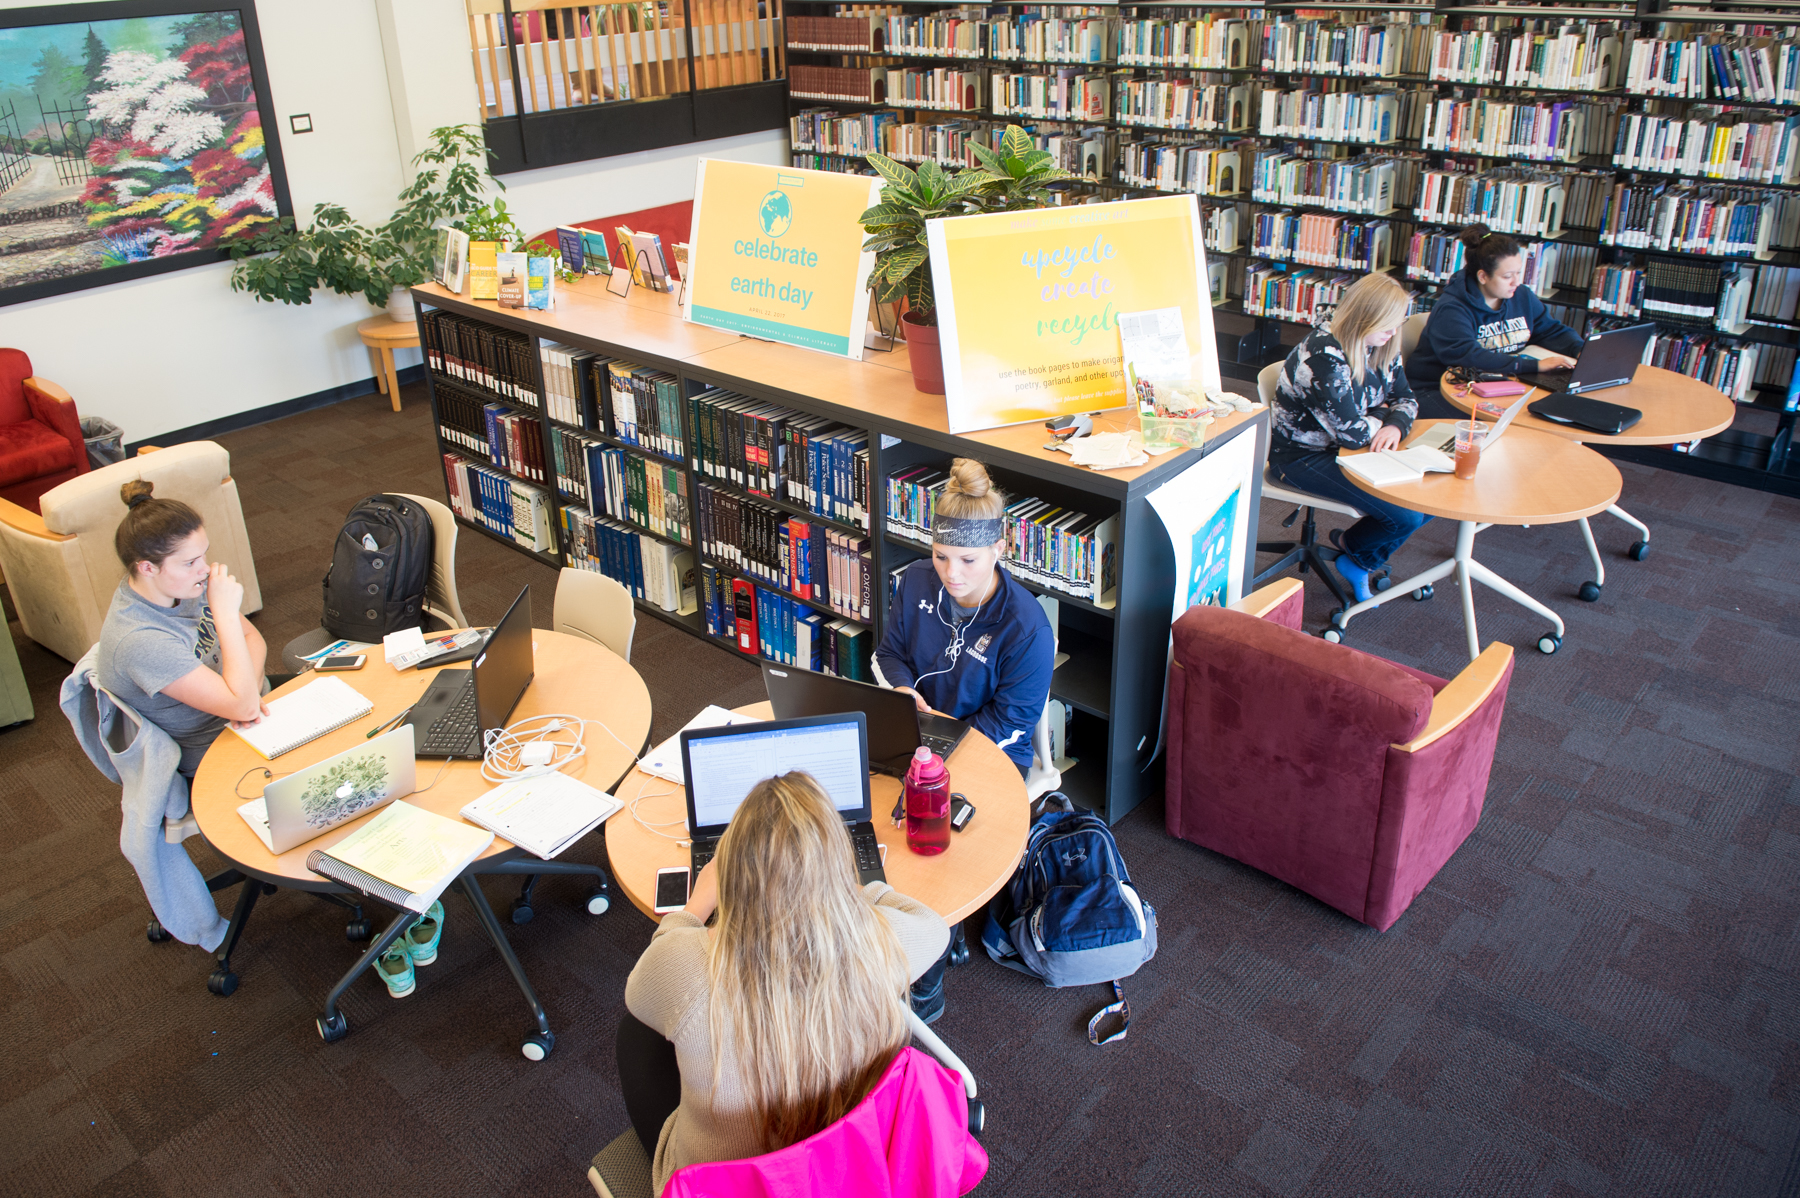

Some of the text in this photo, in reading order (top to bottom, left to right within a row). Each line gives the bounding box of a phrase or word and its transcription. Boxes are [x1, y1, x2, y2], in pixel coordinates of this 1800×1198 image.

[1010, 208, 1129, 230] make some creative art
[734, 237, 819, 268] celebrate
[1021, 234, 1118, 279] upcycle
[730, 276, 814, 311] earth day
[1040, 271, 1116, 302] create
[748, 306, 763, 316] APRIL
[998, 371, 1013, 379] use
[1014, 368, 1027, 377] the
[1028, 365, 1047, 376] book
[1048, 363, 1071, 374] pages
[1072, 360, 1080, 369] to
[1081, 358, 1101, 368] make
[1014, 381, 1042, 393] poetry,
[1042, 375, 1073, 390] garland,
[1074, 373, 1088, 383] and
[1089, 370, 1108, 382] other
[1064, 394, 1080, 403] please
[1080, 392, 1094, 400] leave
